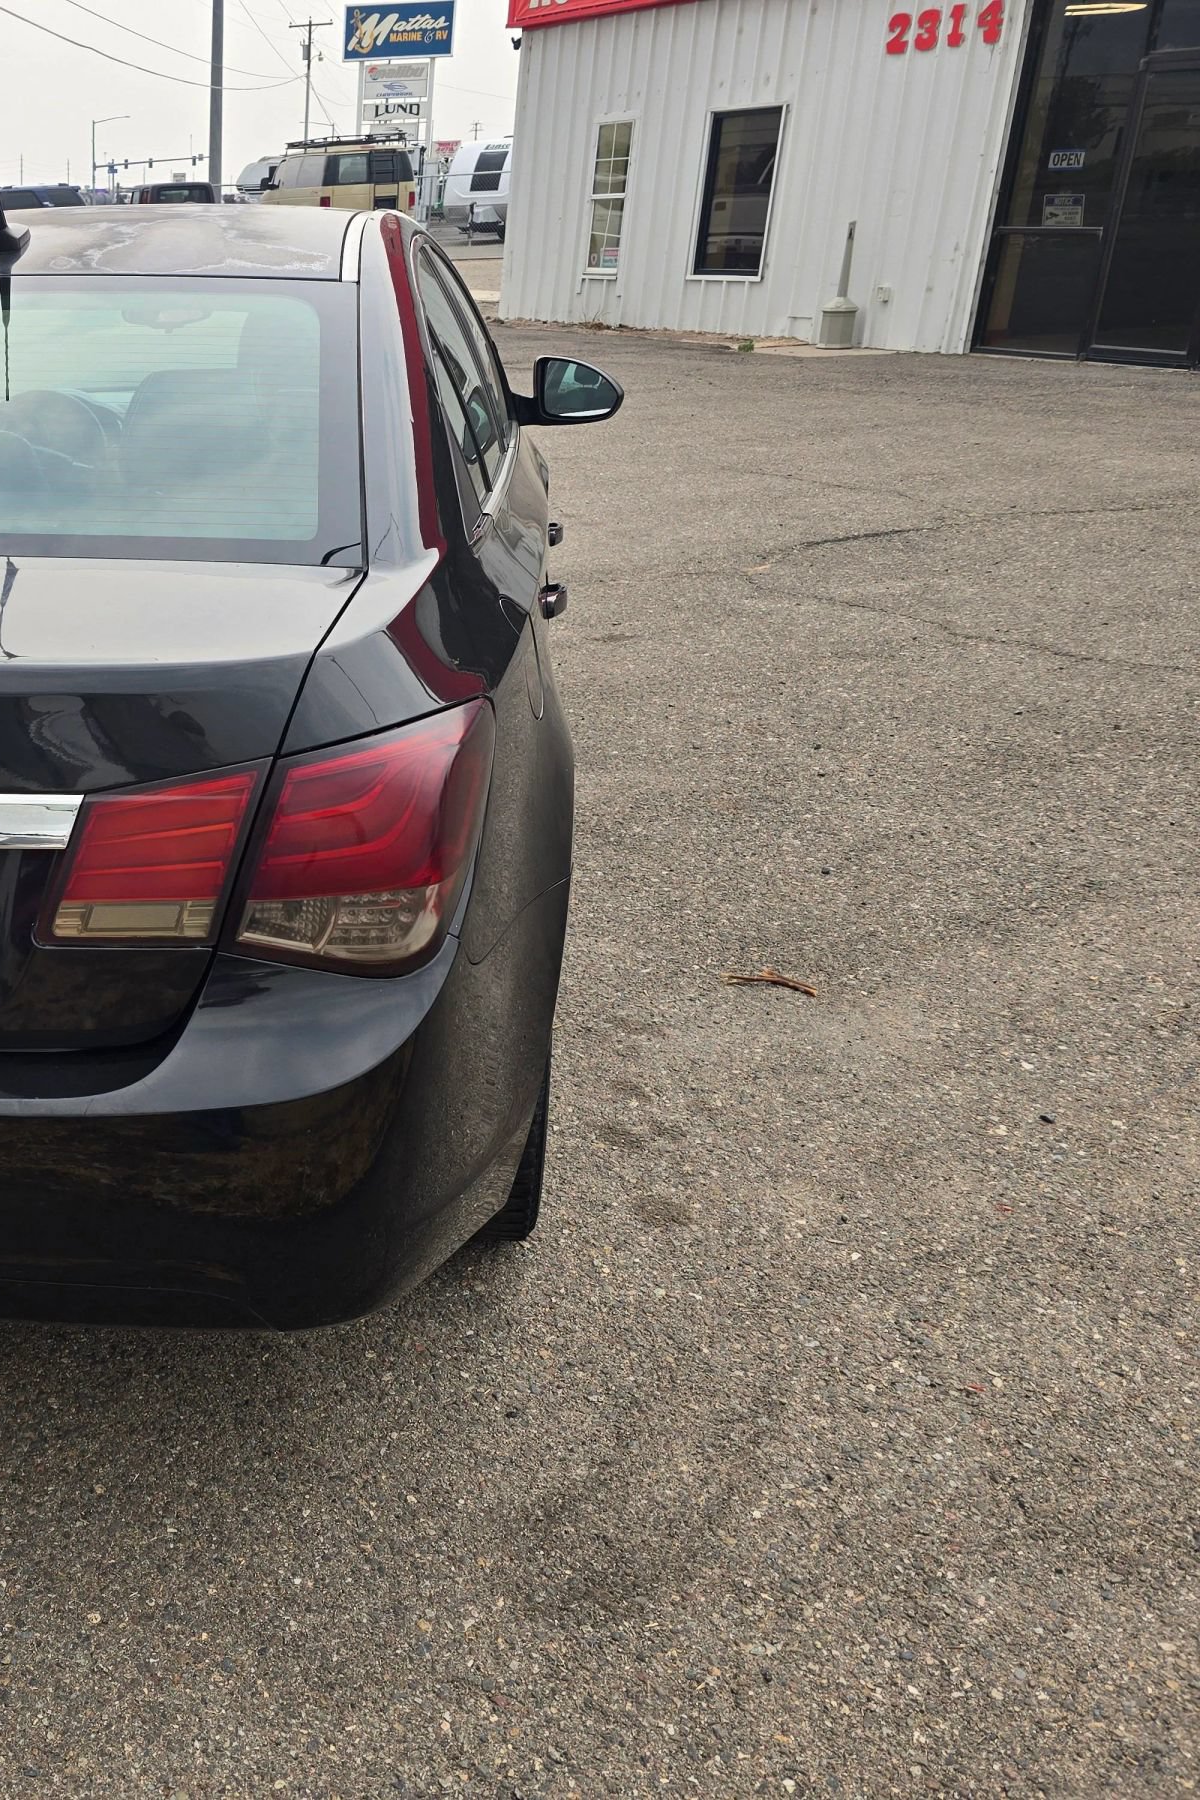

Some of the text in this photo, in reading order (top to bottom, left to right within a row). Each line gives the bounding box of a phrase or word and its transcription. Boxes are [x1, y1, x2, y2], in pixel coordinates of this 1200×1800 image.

[347, 13, 449, 51] Mattas
[886, 0, 1004, 54] 2314
[389, 30, 448, 43] MARINE & RV
[375, 103, 420, 118] LUND
[1052, 153, 1082, 166] OPEN
